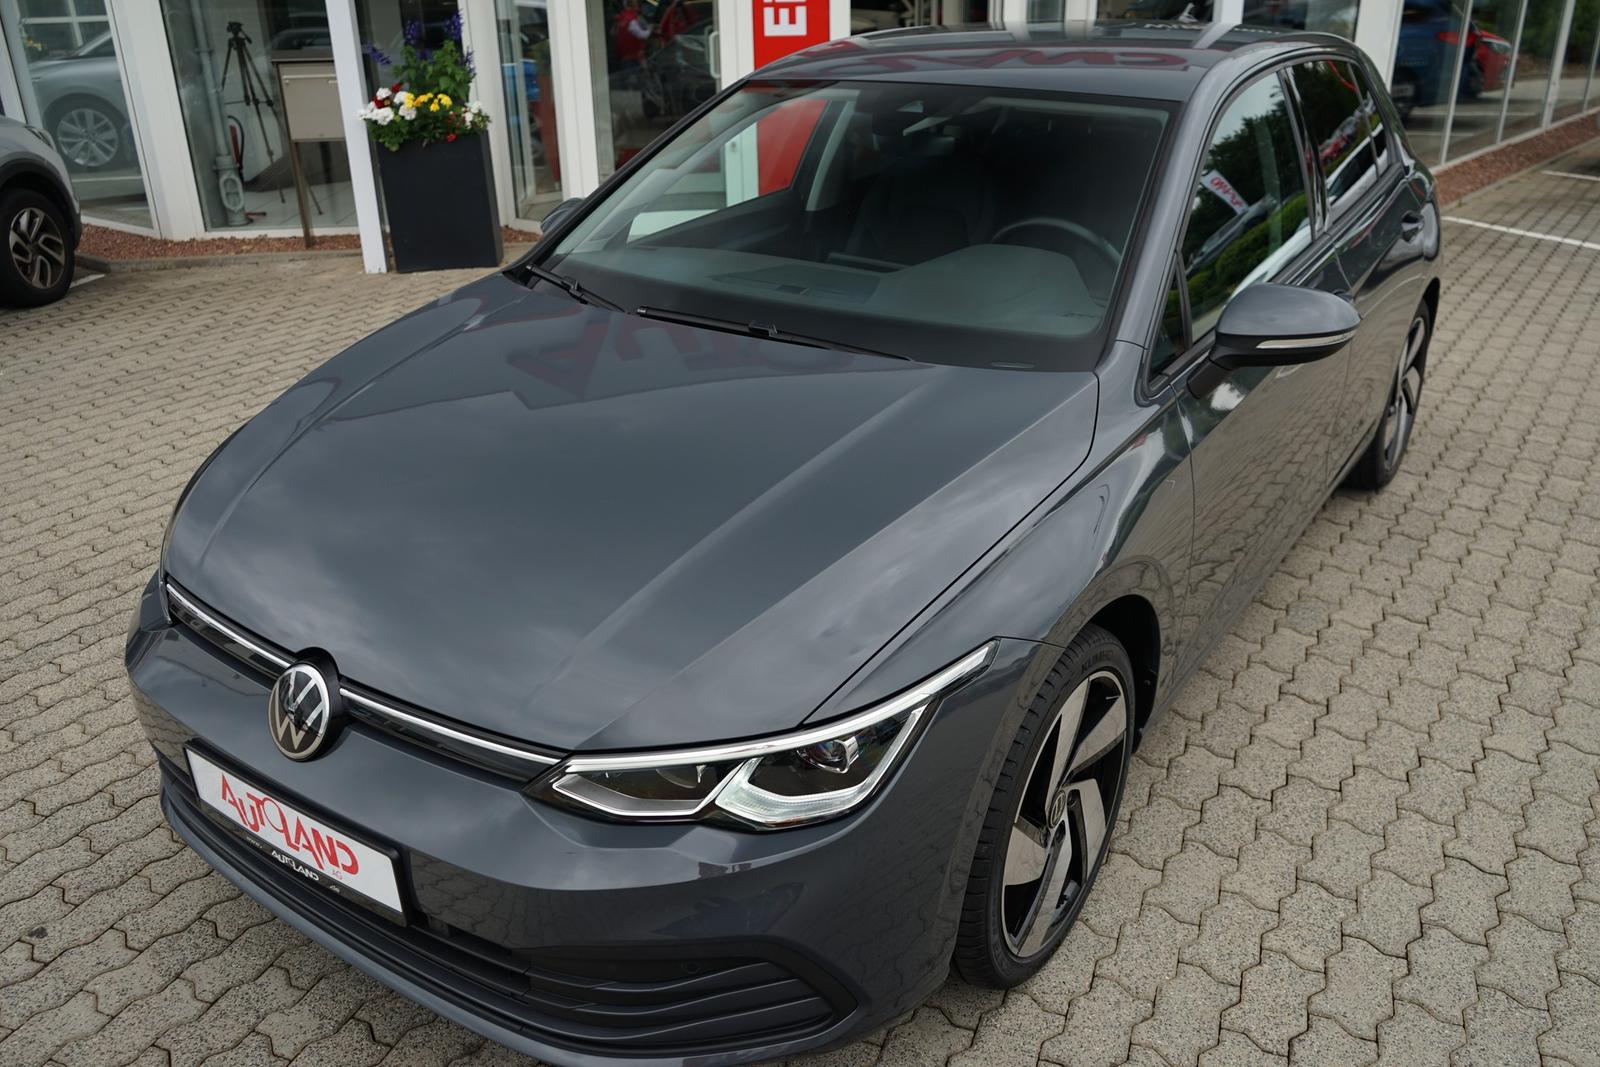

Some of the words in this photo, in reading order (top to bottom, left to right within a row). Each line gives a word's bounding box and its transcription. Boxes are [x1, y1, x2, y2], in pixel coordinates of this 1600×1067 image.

[763, 0, 807, 36] E
[222, 772, 359, 875] AUTOLAND
[271, 850, 319, 880] AUTOLAND
